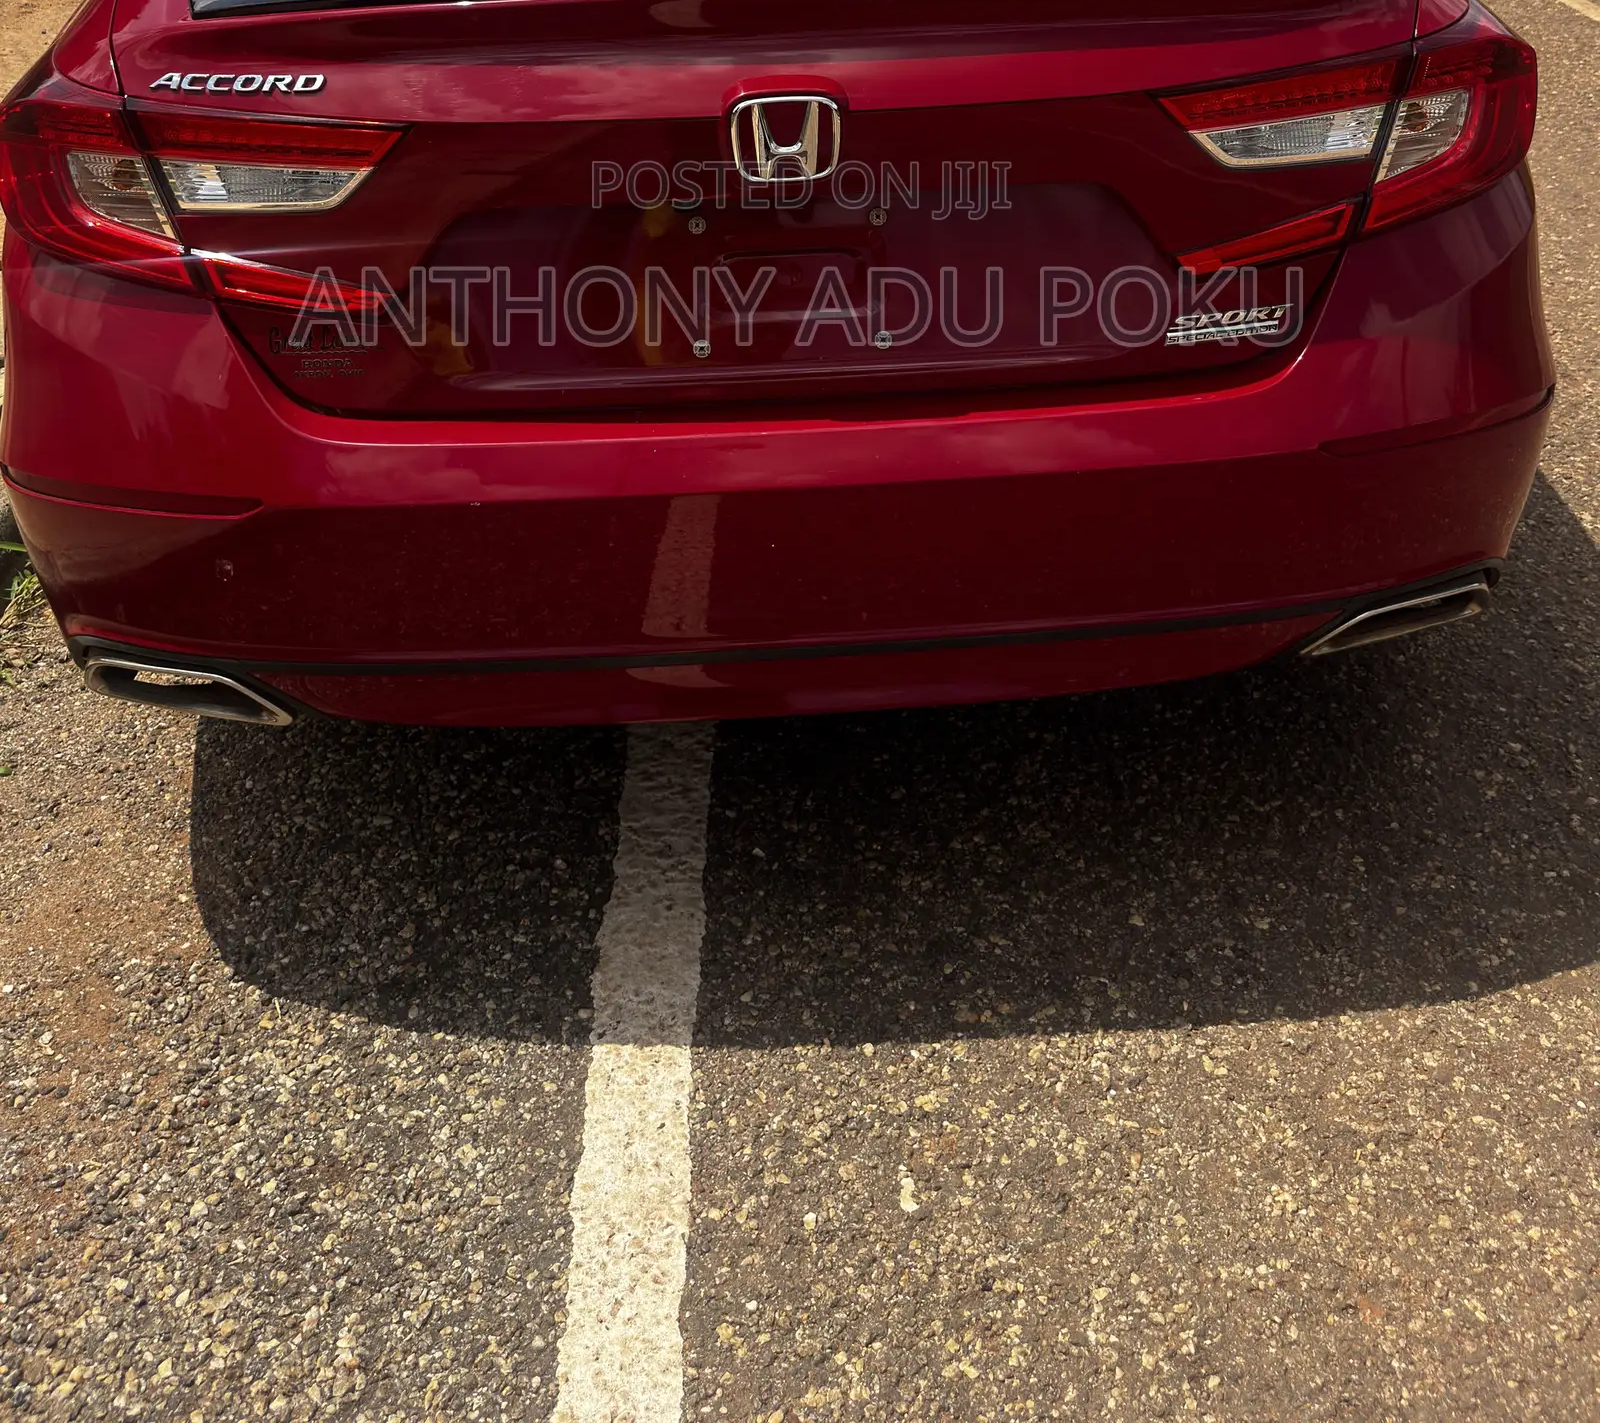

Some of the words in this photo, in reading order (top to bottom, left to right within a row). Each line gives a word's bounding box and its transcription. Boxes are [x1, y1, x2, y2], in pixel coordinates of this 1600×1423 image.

[150, 72, 327, 92] ACCORD
[1169, 303, 1294, 330] SPORT
[1167, 332, 1223, 344] SPECIAL
